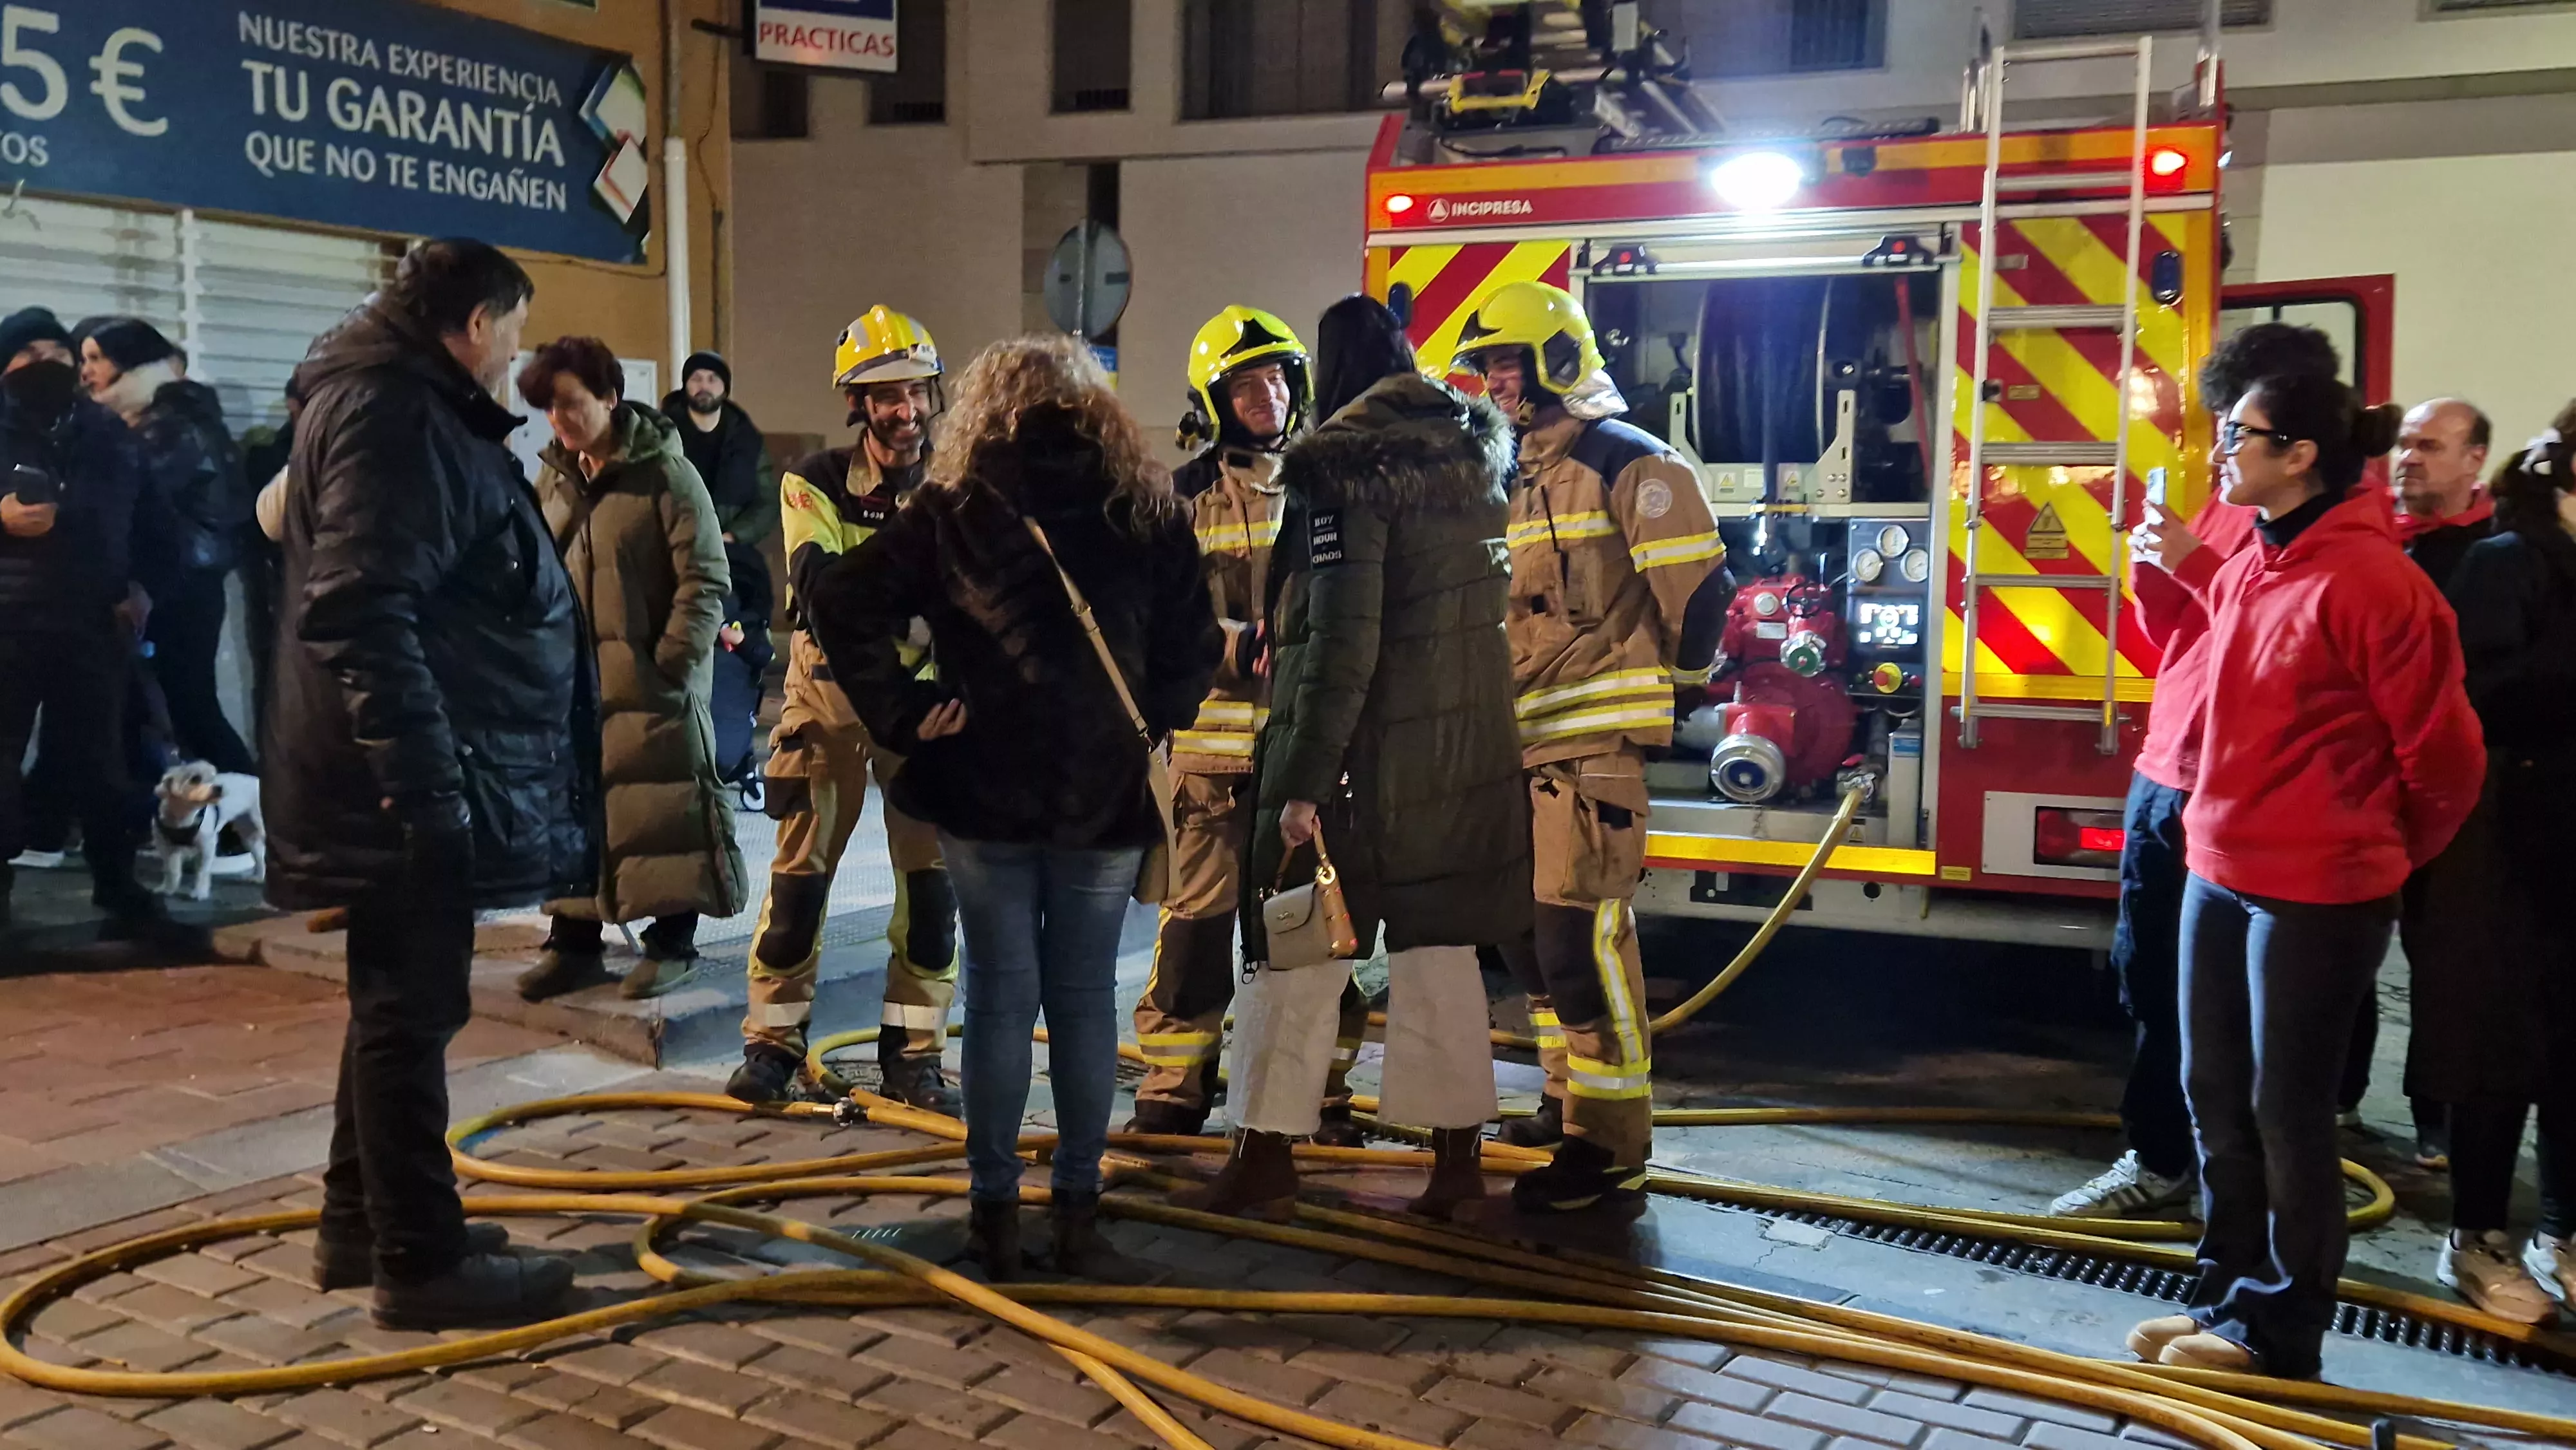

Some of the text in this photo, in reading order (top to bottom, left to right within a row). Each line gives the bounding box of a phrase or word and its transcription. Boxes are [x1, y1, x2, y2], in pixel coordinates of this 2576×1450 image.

[238, 10, 563, 108] NUESTRA EXPERIENCIA
[758, 21, 896, 59] PRACTICAS
[88, 27, 168, 137] €
[242, 60, 565, 168] TU GARANTÍA
[0, 128, 49, 167] OS
[245, 130, 567, 213] QUE NO TE ENGAÑEN
[1451, 199, 1534, 217] INCIPRESA
